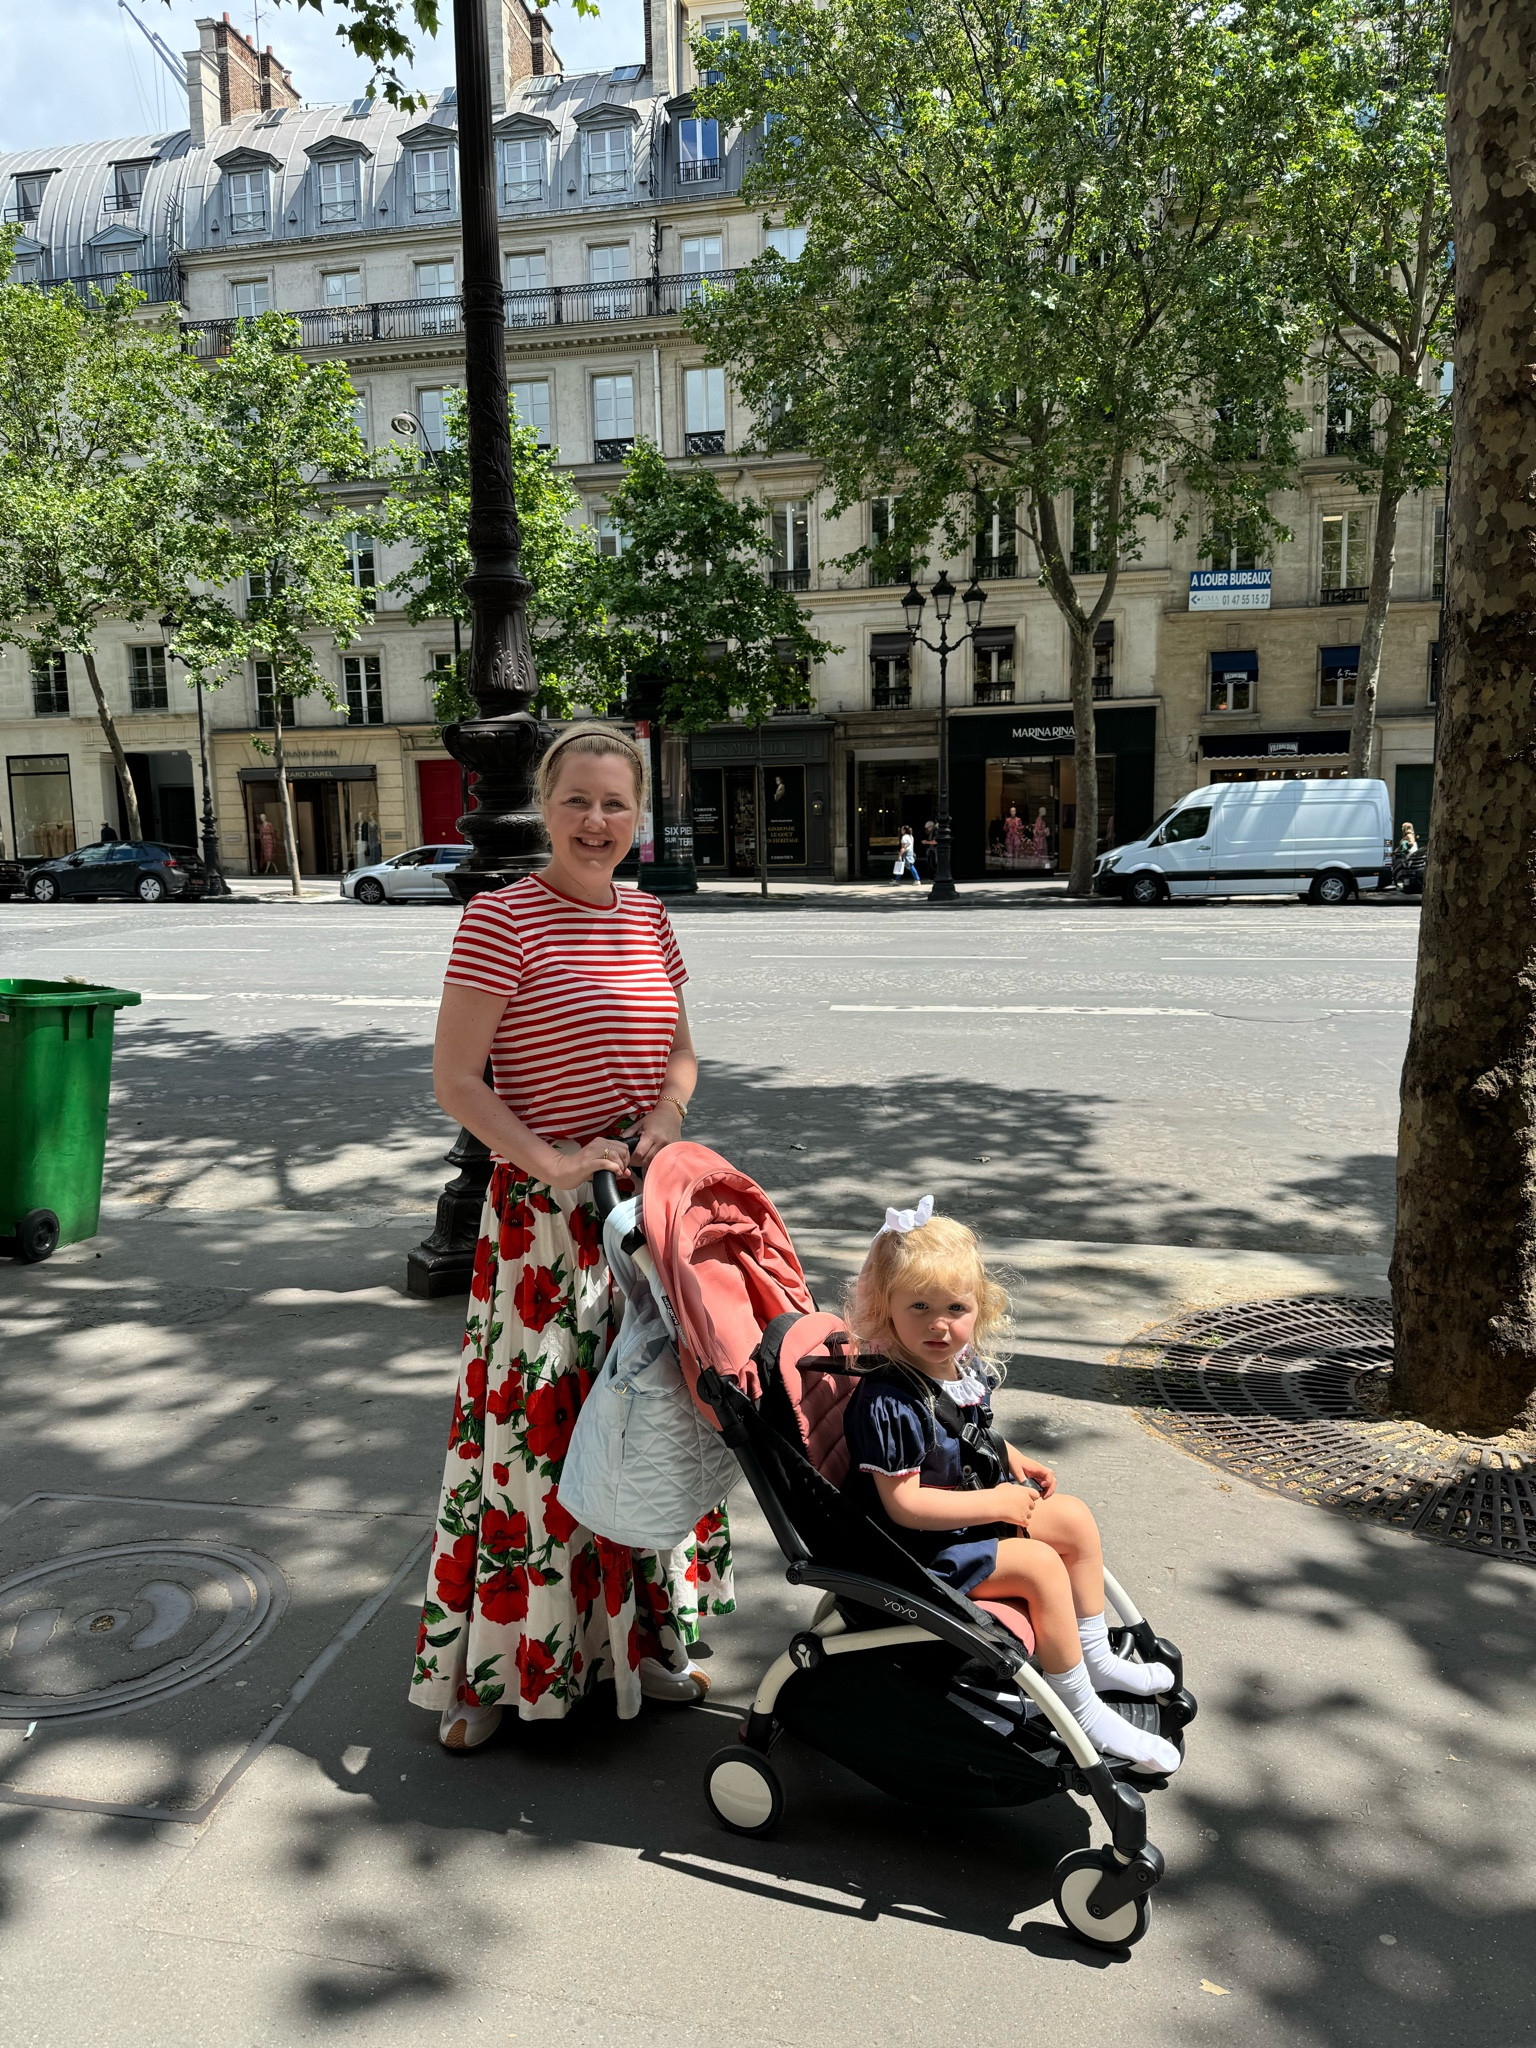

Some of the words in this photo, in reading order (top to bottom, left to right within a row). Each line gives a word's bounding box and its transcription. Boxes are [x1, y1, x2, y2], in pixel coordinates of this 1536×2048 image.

[1191, 574, 1199, 587] A
[1200, 573, 1229, 587] LOUER
[1230, 571, 1271, 586] BUREAUX
[1222, 594, 1230, 605] 01
[1232, 594, 1240, 605] 47
[1241, 594, 1250, 605] 55
[1251, 594, 1260, 604] 15
[1261, 593, 1269, 604] 27
[1012, 726, 1052, 739] MARINA
[1052, 726, 1076, 739] RINA
[308, 770, 334, 778] DAREL
[664, 826, 679, 836] SIX
[883, 1597, 918, 1619] YOYO
